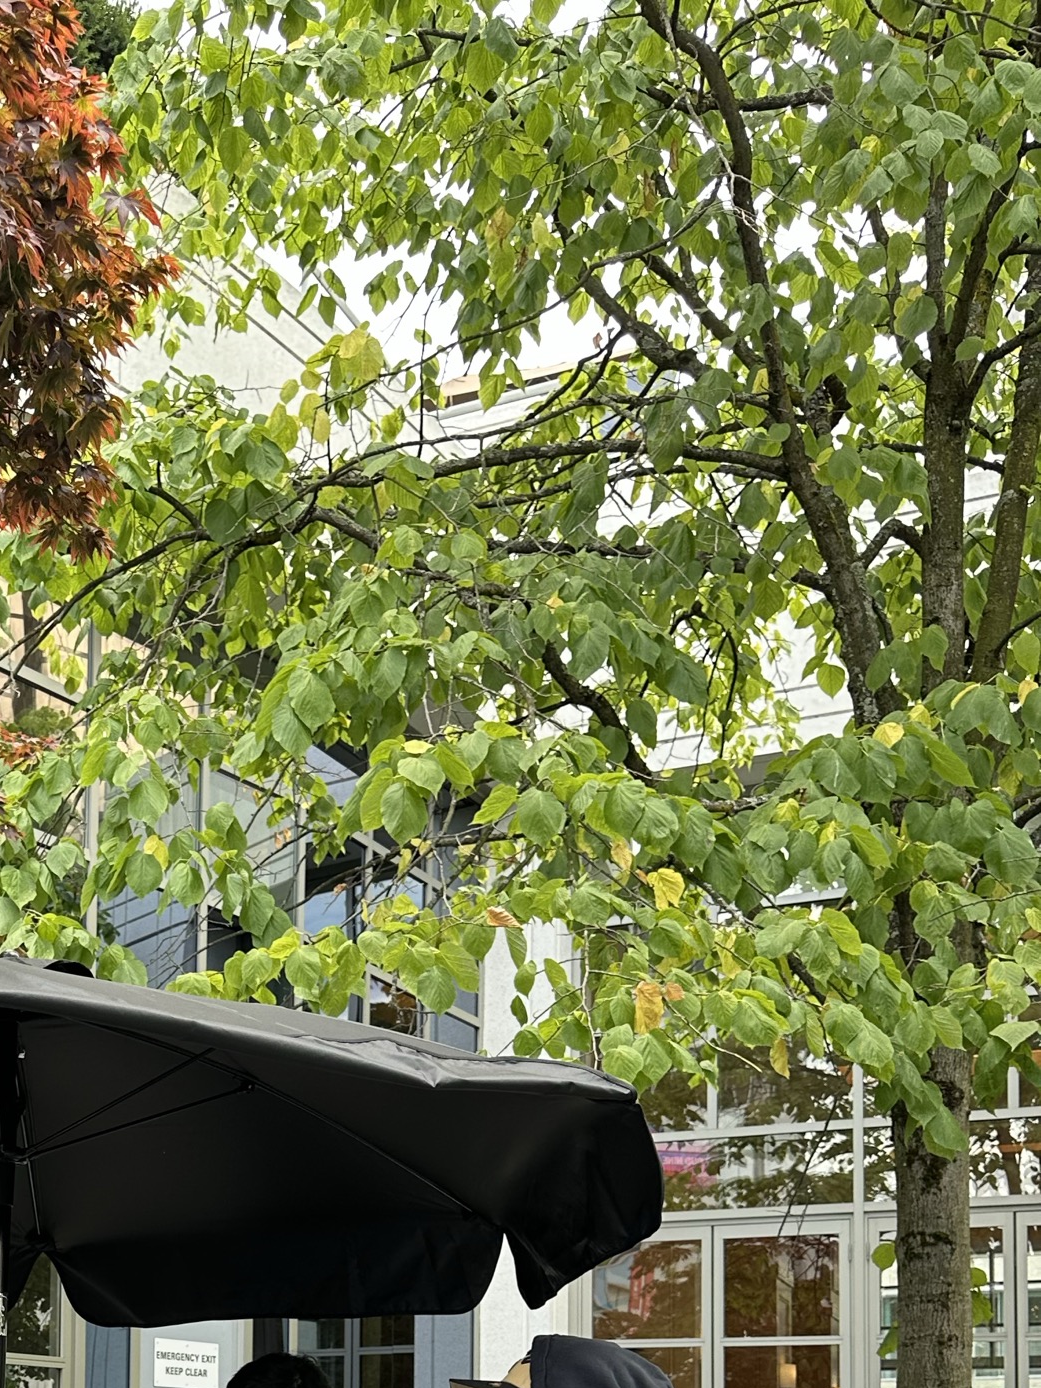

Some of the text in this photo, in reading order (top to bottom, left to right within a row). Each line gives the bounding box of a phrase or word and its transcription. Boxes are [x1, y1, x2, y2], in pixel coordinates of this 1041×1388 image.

[156, 1351, 216, 1363] EMERGENCY EXIT
[165, 1366, 208, 1377] KEEP CLEAR
